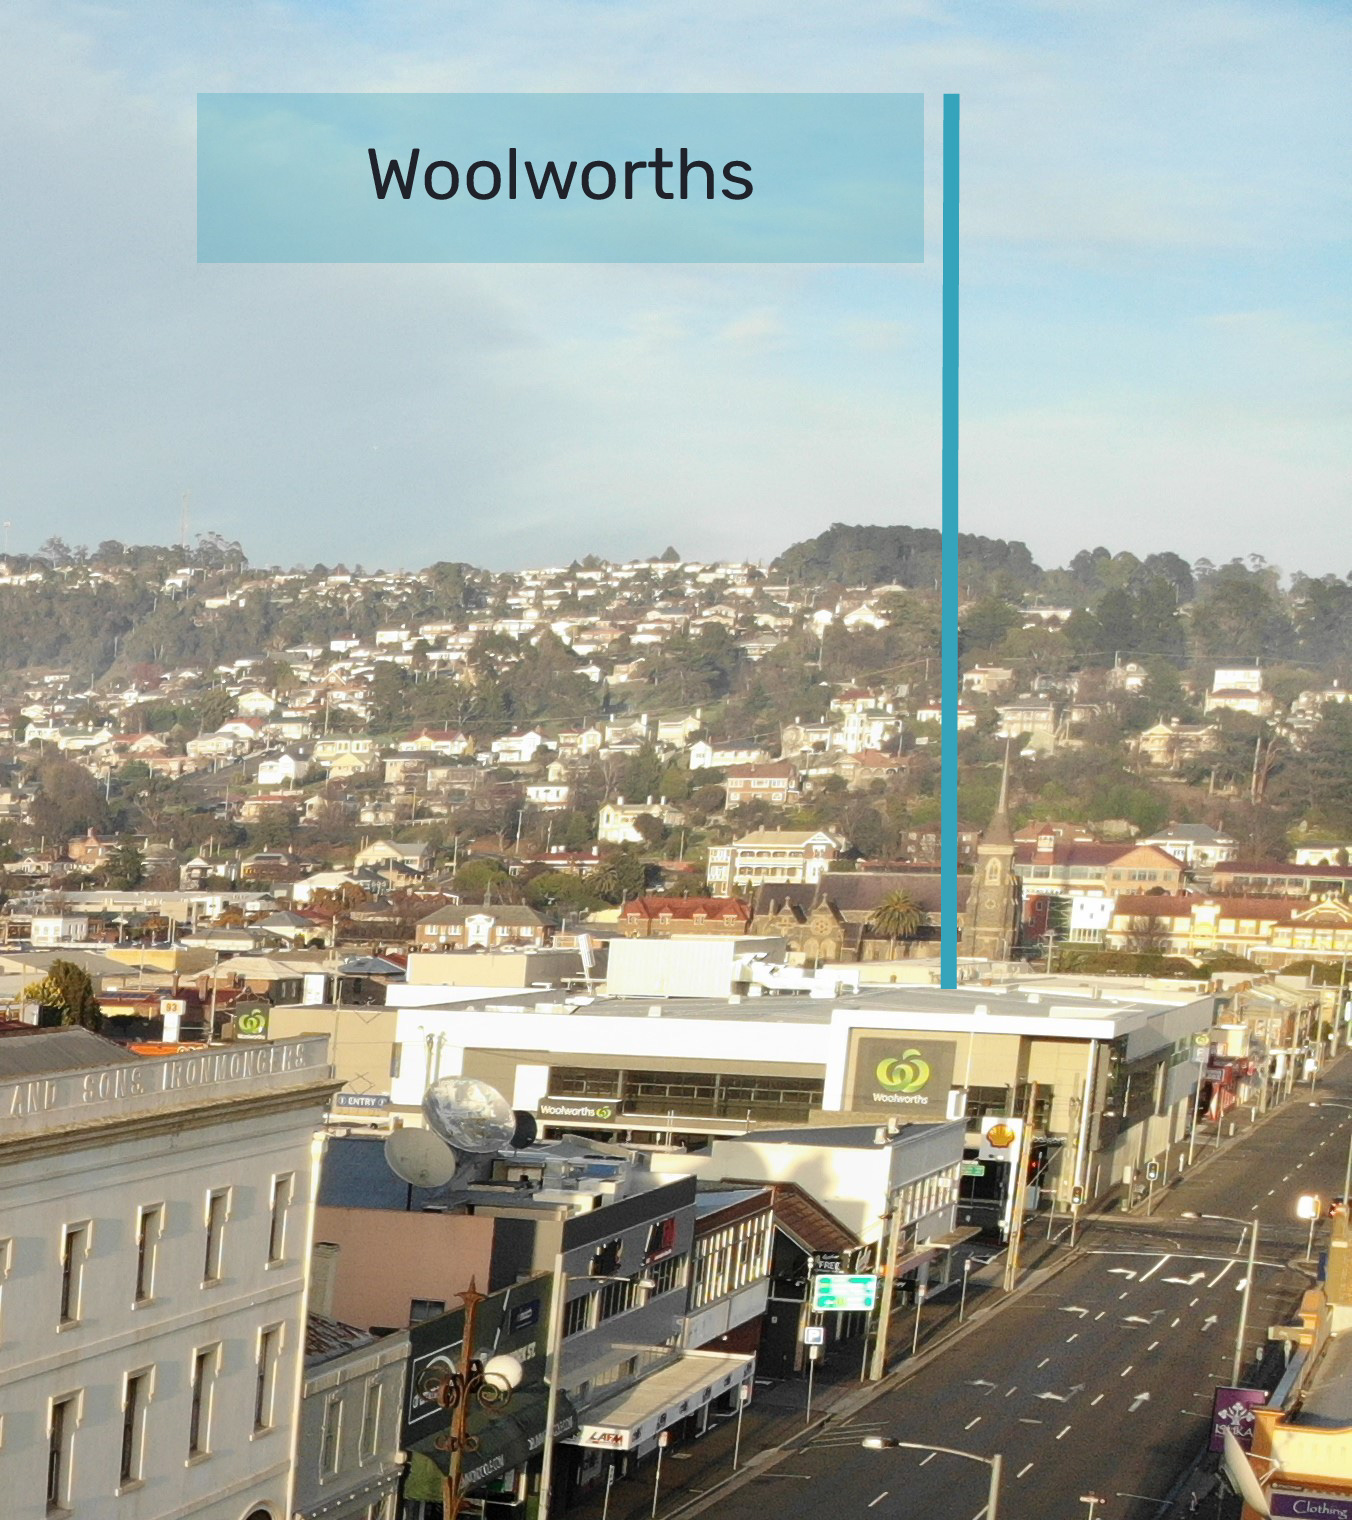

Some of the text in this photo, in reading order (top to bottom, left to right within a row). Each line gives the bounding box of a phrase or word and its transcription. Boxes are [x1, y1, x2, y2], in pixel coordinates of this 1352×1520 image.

[10, 1080, 57, 1116] AND
[347, 1096, 377, 1107] ENTRY
[872, 1092, 929, 1105] Woolworths
[540, 1104, 595, 1117] Woolworths
[1292, 1499, 1348, 1520] Clothing
